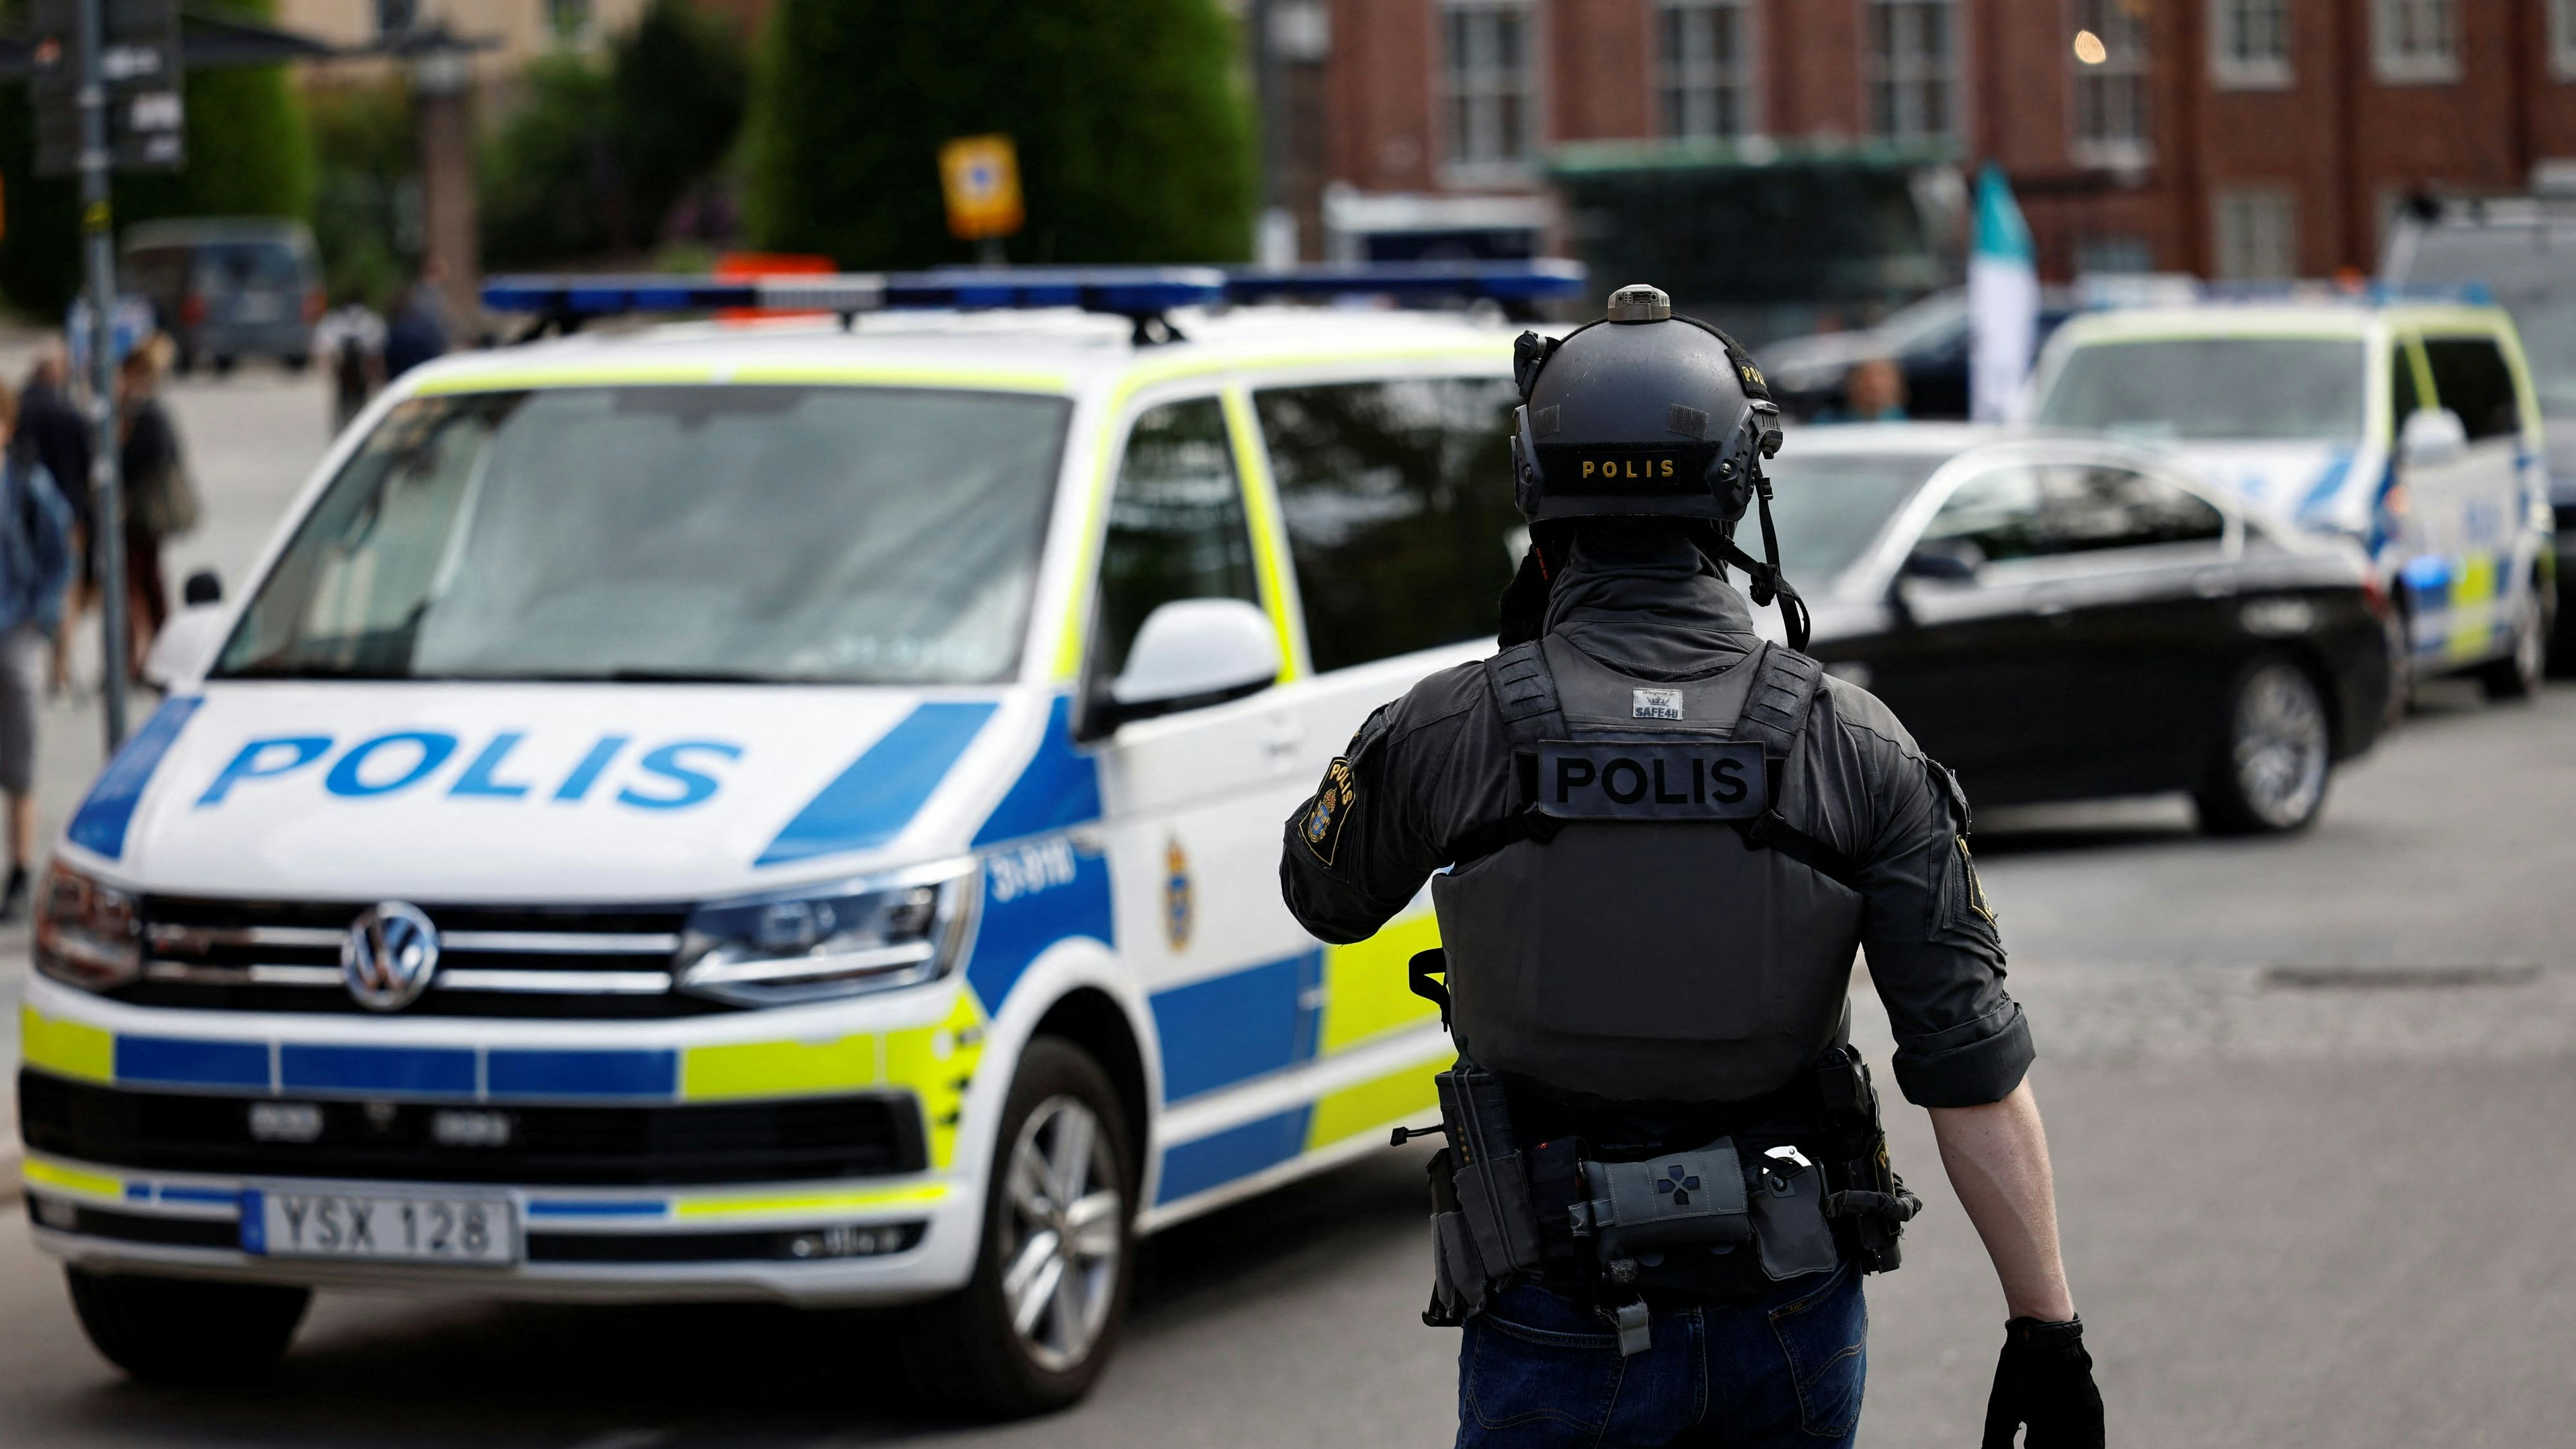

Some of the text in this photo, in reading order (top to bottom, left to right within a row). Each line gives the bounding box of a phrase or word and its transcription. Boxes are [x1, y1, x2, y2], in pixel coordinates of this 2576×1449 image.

[1741, 366, 1767, 389] POL
[1582, 460, 1674, 478] POLIS
[1636, 707, 1679, 718] SAFE4U
[193, 732, 744, 810] POLIS
[1329, 764, 1352, 805] POLIS
[1557, 757, 1748, 804] POLIS
[280, 1196, 490, 1255] YSX 128
